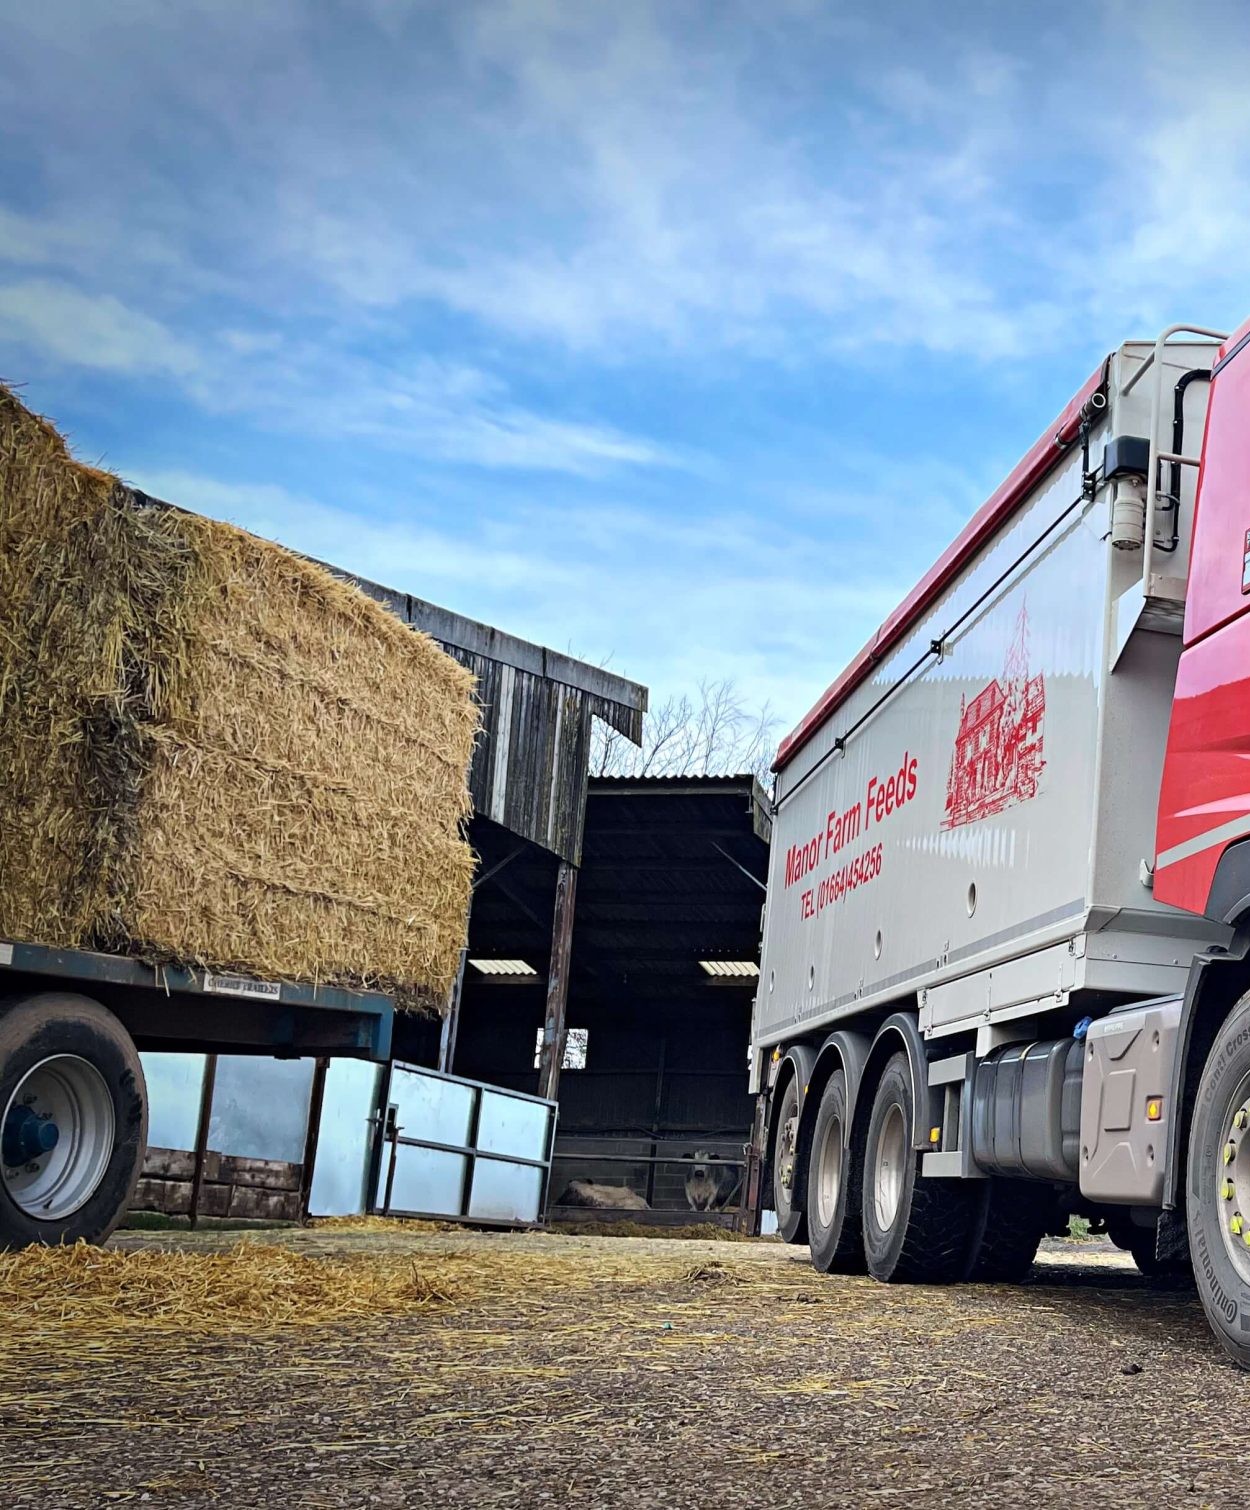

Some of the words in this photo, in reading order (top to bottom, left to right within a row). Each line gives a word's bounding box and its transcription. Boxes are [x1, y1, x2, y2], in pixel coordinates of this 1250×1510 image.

[784, 831, 824, 890] Manor
[825, 802, 861, 860] Farm
[865, 751, 918, 831] Feeds
[801, 888, 815, 921] TEL
[817, 842, 883, 919] (01664)454256
[1204, 1053, 1227, 1102] Conti
[1194, 1229, 1238, 1324] Continental
